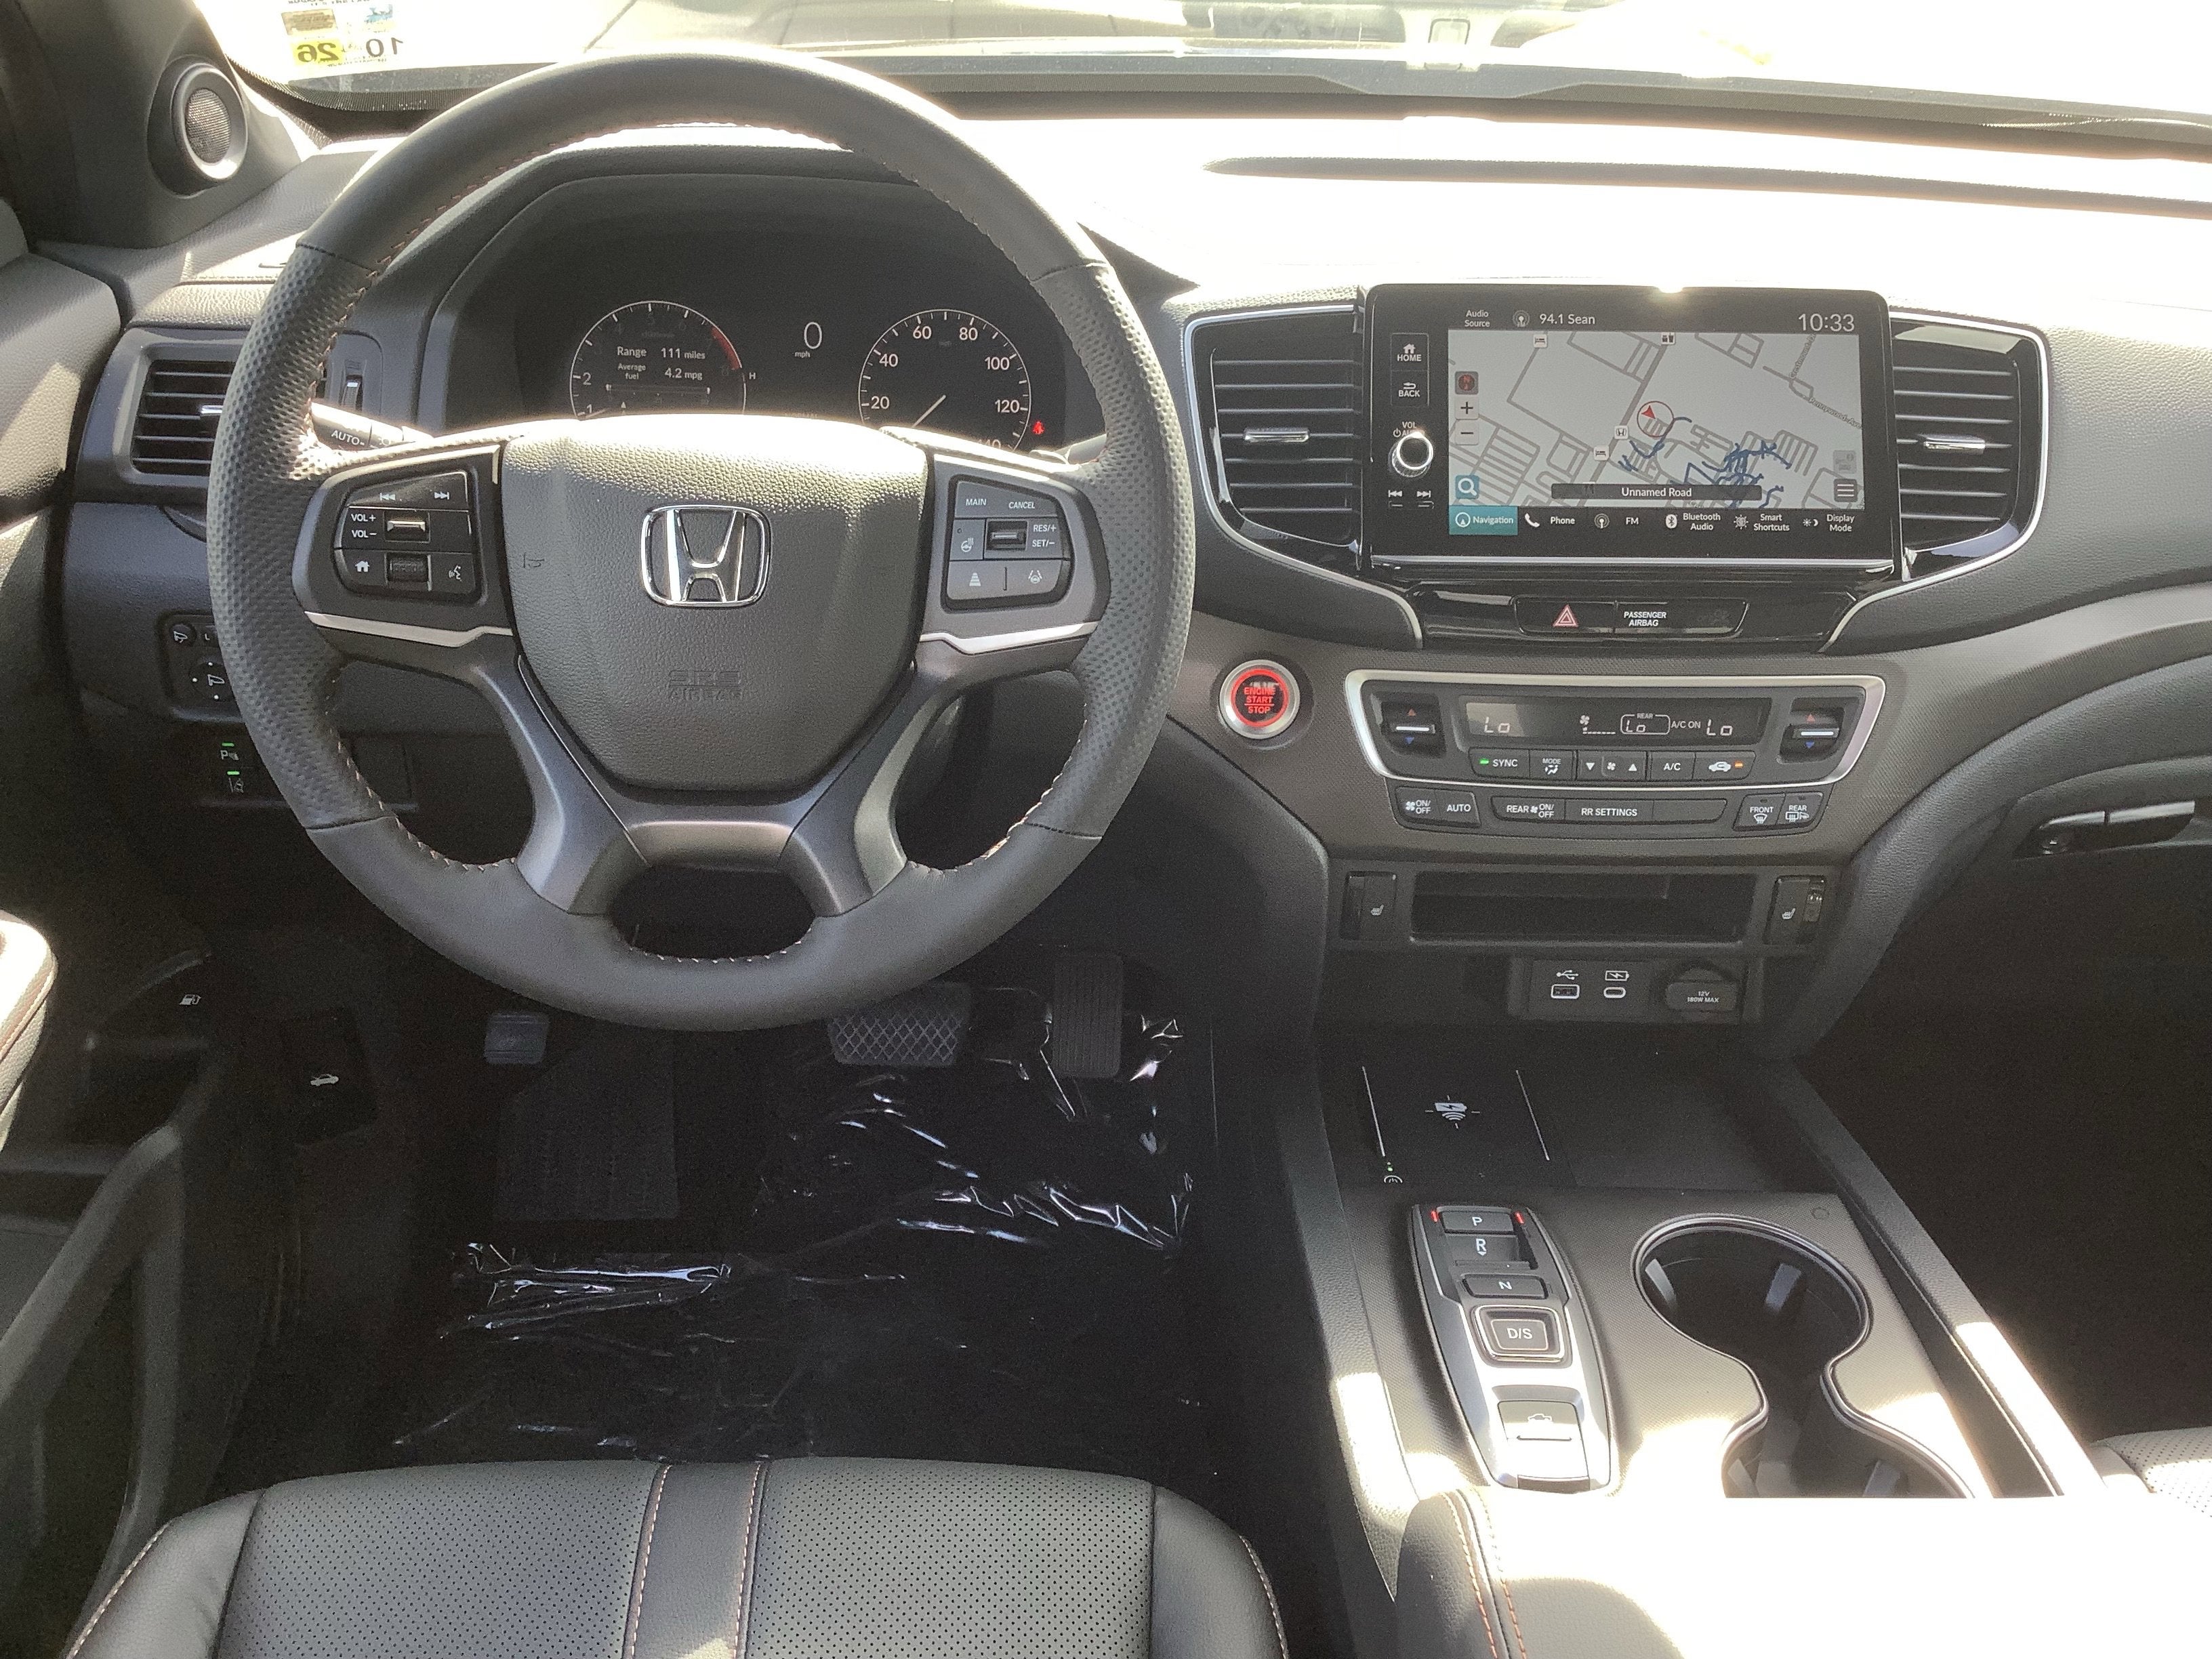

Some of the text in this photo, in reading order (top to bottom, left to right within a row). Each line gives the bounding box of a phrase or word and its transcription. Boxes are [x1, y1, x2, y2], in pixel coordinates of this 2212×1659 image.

[1540, 314, 1595, 324] 94.1 Sean
[1799, 314, 1855, 332] 10:33
[804, 322, 822, 349] 0
[913, 326, 932, 340] 60
[959, 327, 978, 341] 80
[617, 346, 705, 359] Range 111 miles
[879, 353, 899, 367] 40
[985, 356, 1010, 371] 100
[618, 363, 646, 371] Average
[665, 368, 702, 381] 4.2 mpg
[583, 373, 592, 386] 2
[871, 396, 890, 409] 20
[995, 399, 1020, 413] 120
[1402, 421, 1416, 429] VOL
[331, 430, 361, 445] AUTO
[1621, 488, 1692, 497] Unnamed Road
[1473, 516, 1514, 525] Navigation
[1683, 513, 1721, 521] Bluetooth
[1760, 513, 1782, 522] Smart
[1826, 514, 1855, 524] Display
[1753, 523, 1790, 531] Shortcuts
[1830, 524, 1852, 532] Mode
[1244, 687, 1276, 695] ENGINE
[1671, 720, 1687, 729] A/C
[1493, 758, 1518, 767] SYNC
[1664, 762, 1681, 771] A/C
[1416, 800, 1431, 808] ON/
[1447, 804, 1471, 813] AUTO
[1507, 804, 1529, 813] REAR
[1581, 808, 1637, 817] RR SETTINGS
[1472, 1216, 1482, 1226] P
[1475, 1239, 1486, 1252] R
[1498, 1281, 1512, 1290] N
[1507, 1328, 1533, 1340] D/S
